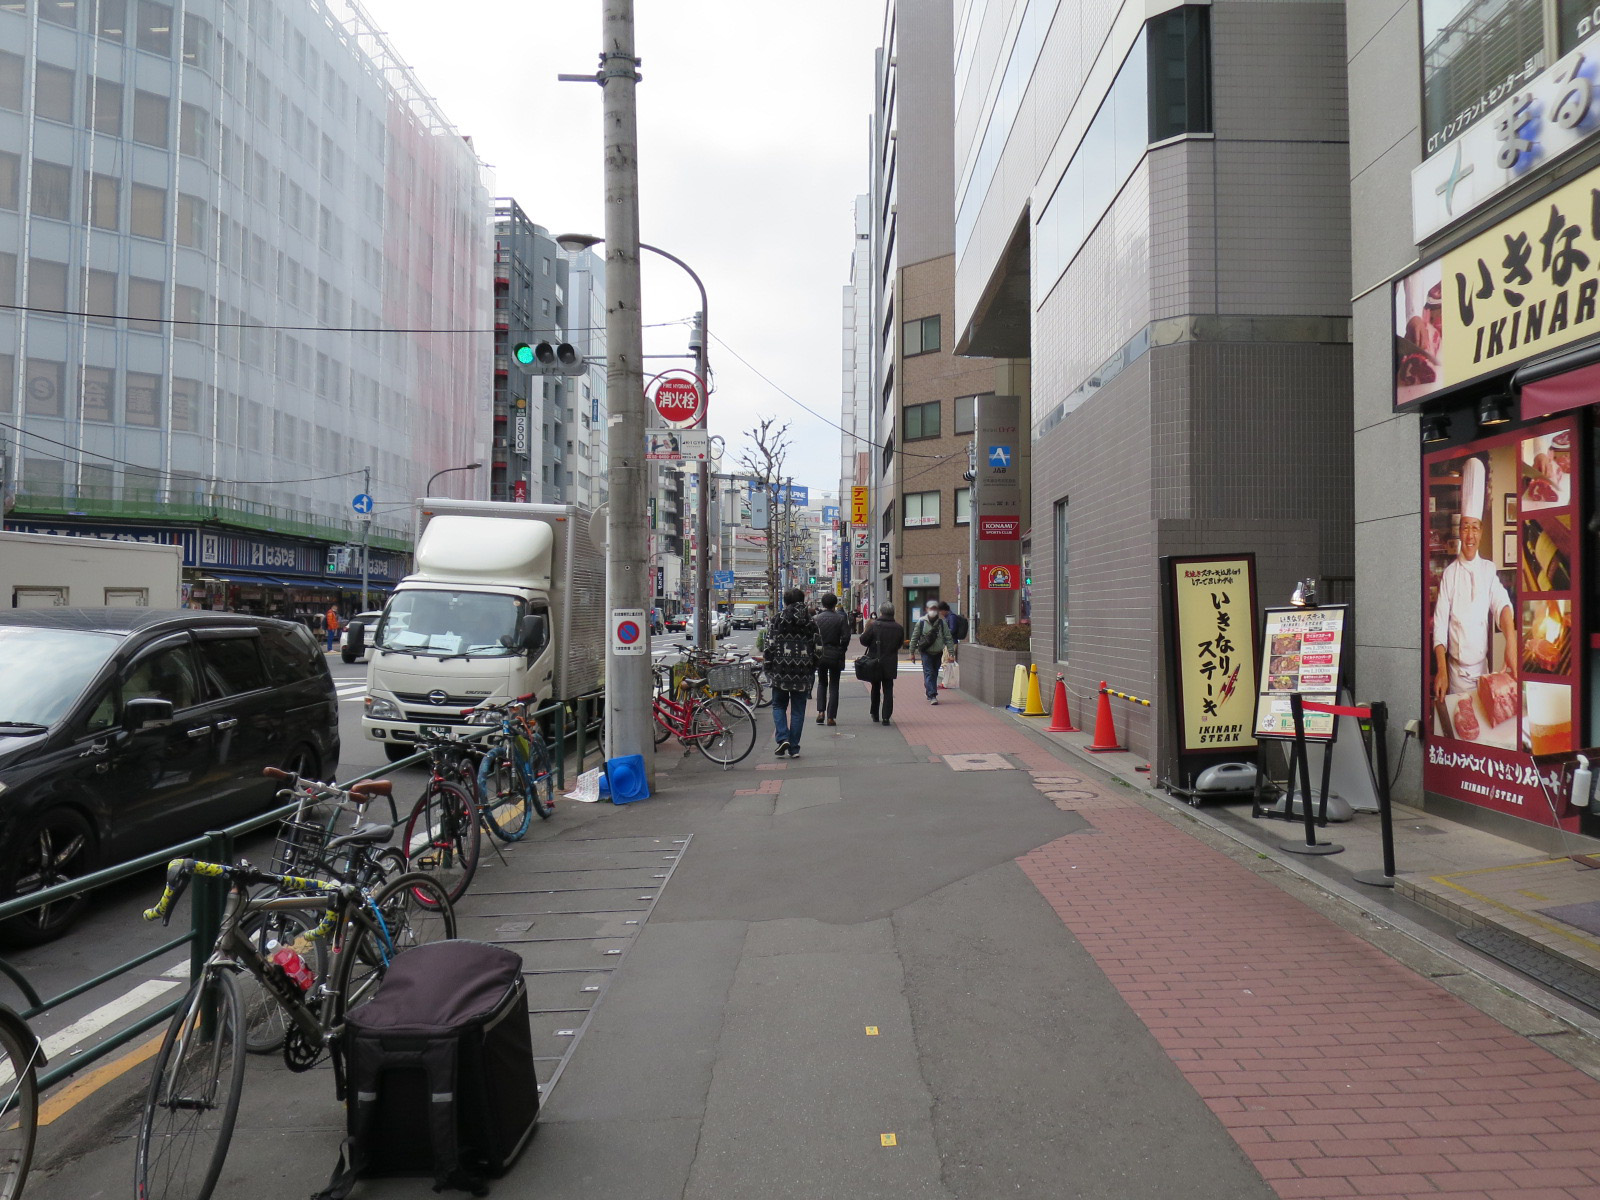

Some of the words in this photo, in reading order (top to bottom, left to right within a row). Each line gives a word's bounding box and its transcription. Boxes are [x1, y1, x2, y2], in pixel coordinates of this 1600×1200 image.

[659, 391, 696, 409] 消火栓
[517, 417, 525, 449] 2900
[854, 487, 868, 523] デニーズ
[266, 545, 295, 567] はるやま
[1280, 614, 1302, 622] いきなり
[1211, 592, 1235, 676] いきなり
[1198, 641, 1217, 717] ステーキ
[1199, 724, 1243, 734] IKINARI
[1200, 734, 1240, 743] STEAK
[1460, 780, 1489, 796] IKINARI
[1495, 788, 1524, 806] STEAK
